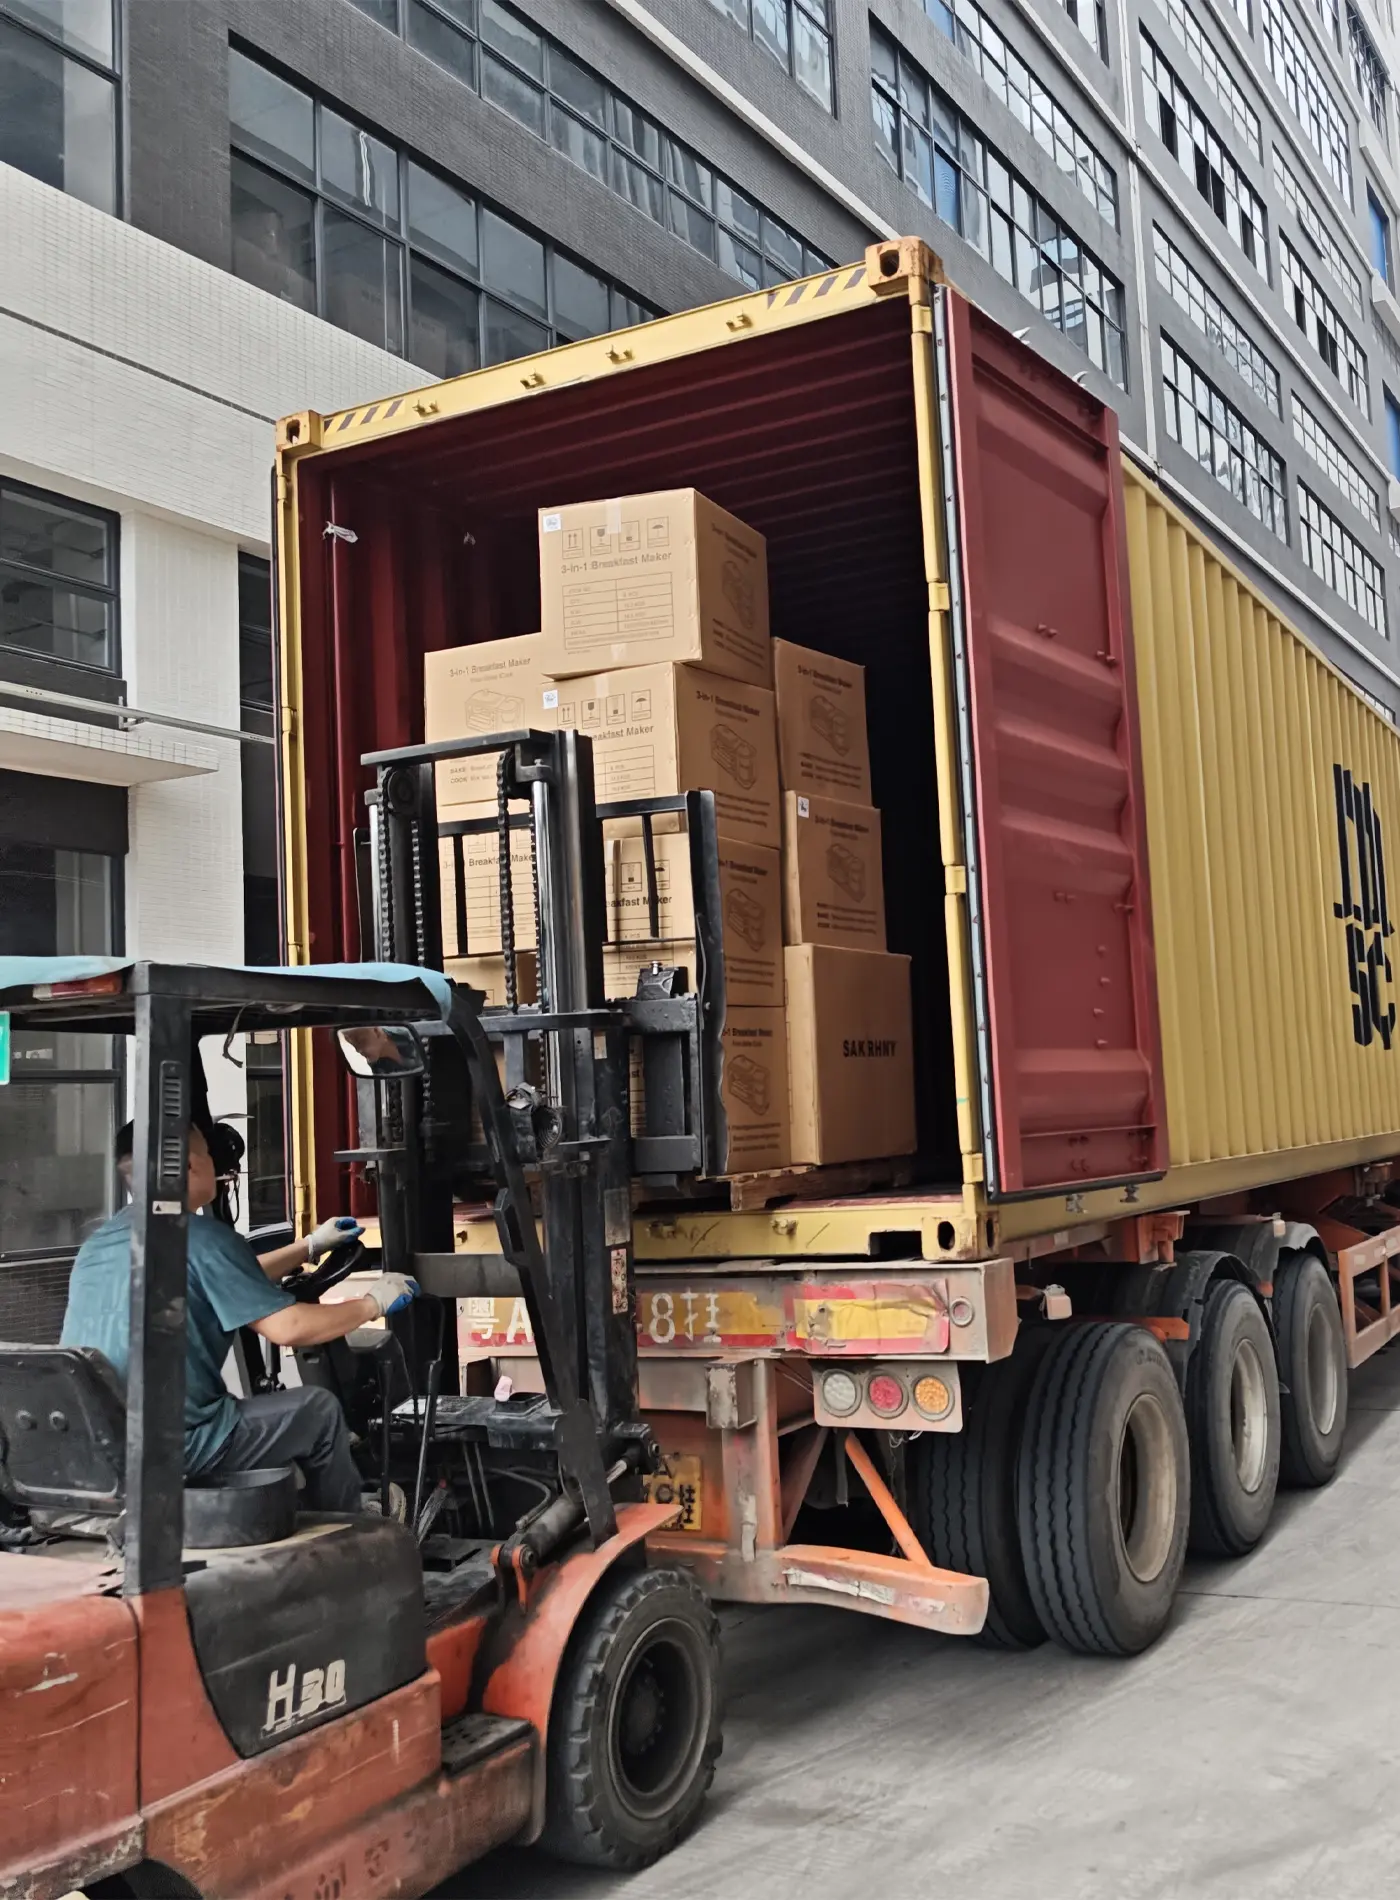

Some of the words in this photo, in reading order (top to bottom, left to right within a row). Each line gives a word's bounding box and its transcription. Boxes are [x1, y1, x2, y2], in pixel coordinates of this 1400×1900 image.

[561, 562, 588, 574] 3-in-1
[641, 551, 672, 563] Maker
[592, 728, 624, 741] eakfast
[626, 724, 655, 737] Maker
[511, 853, 533, 863] Make
